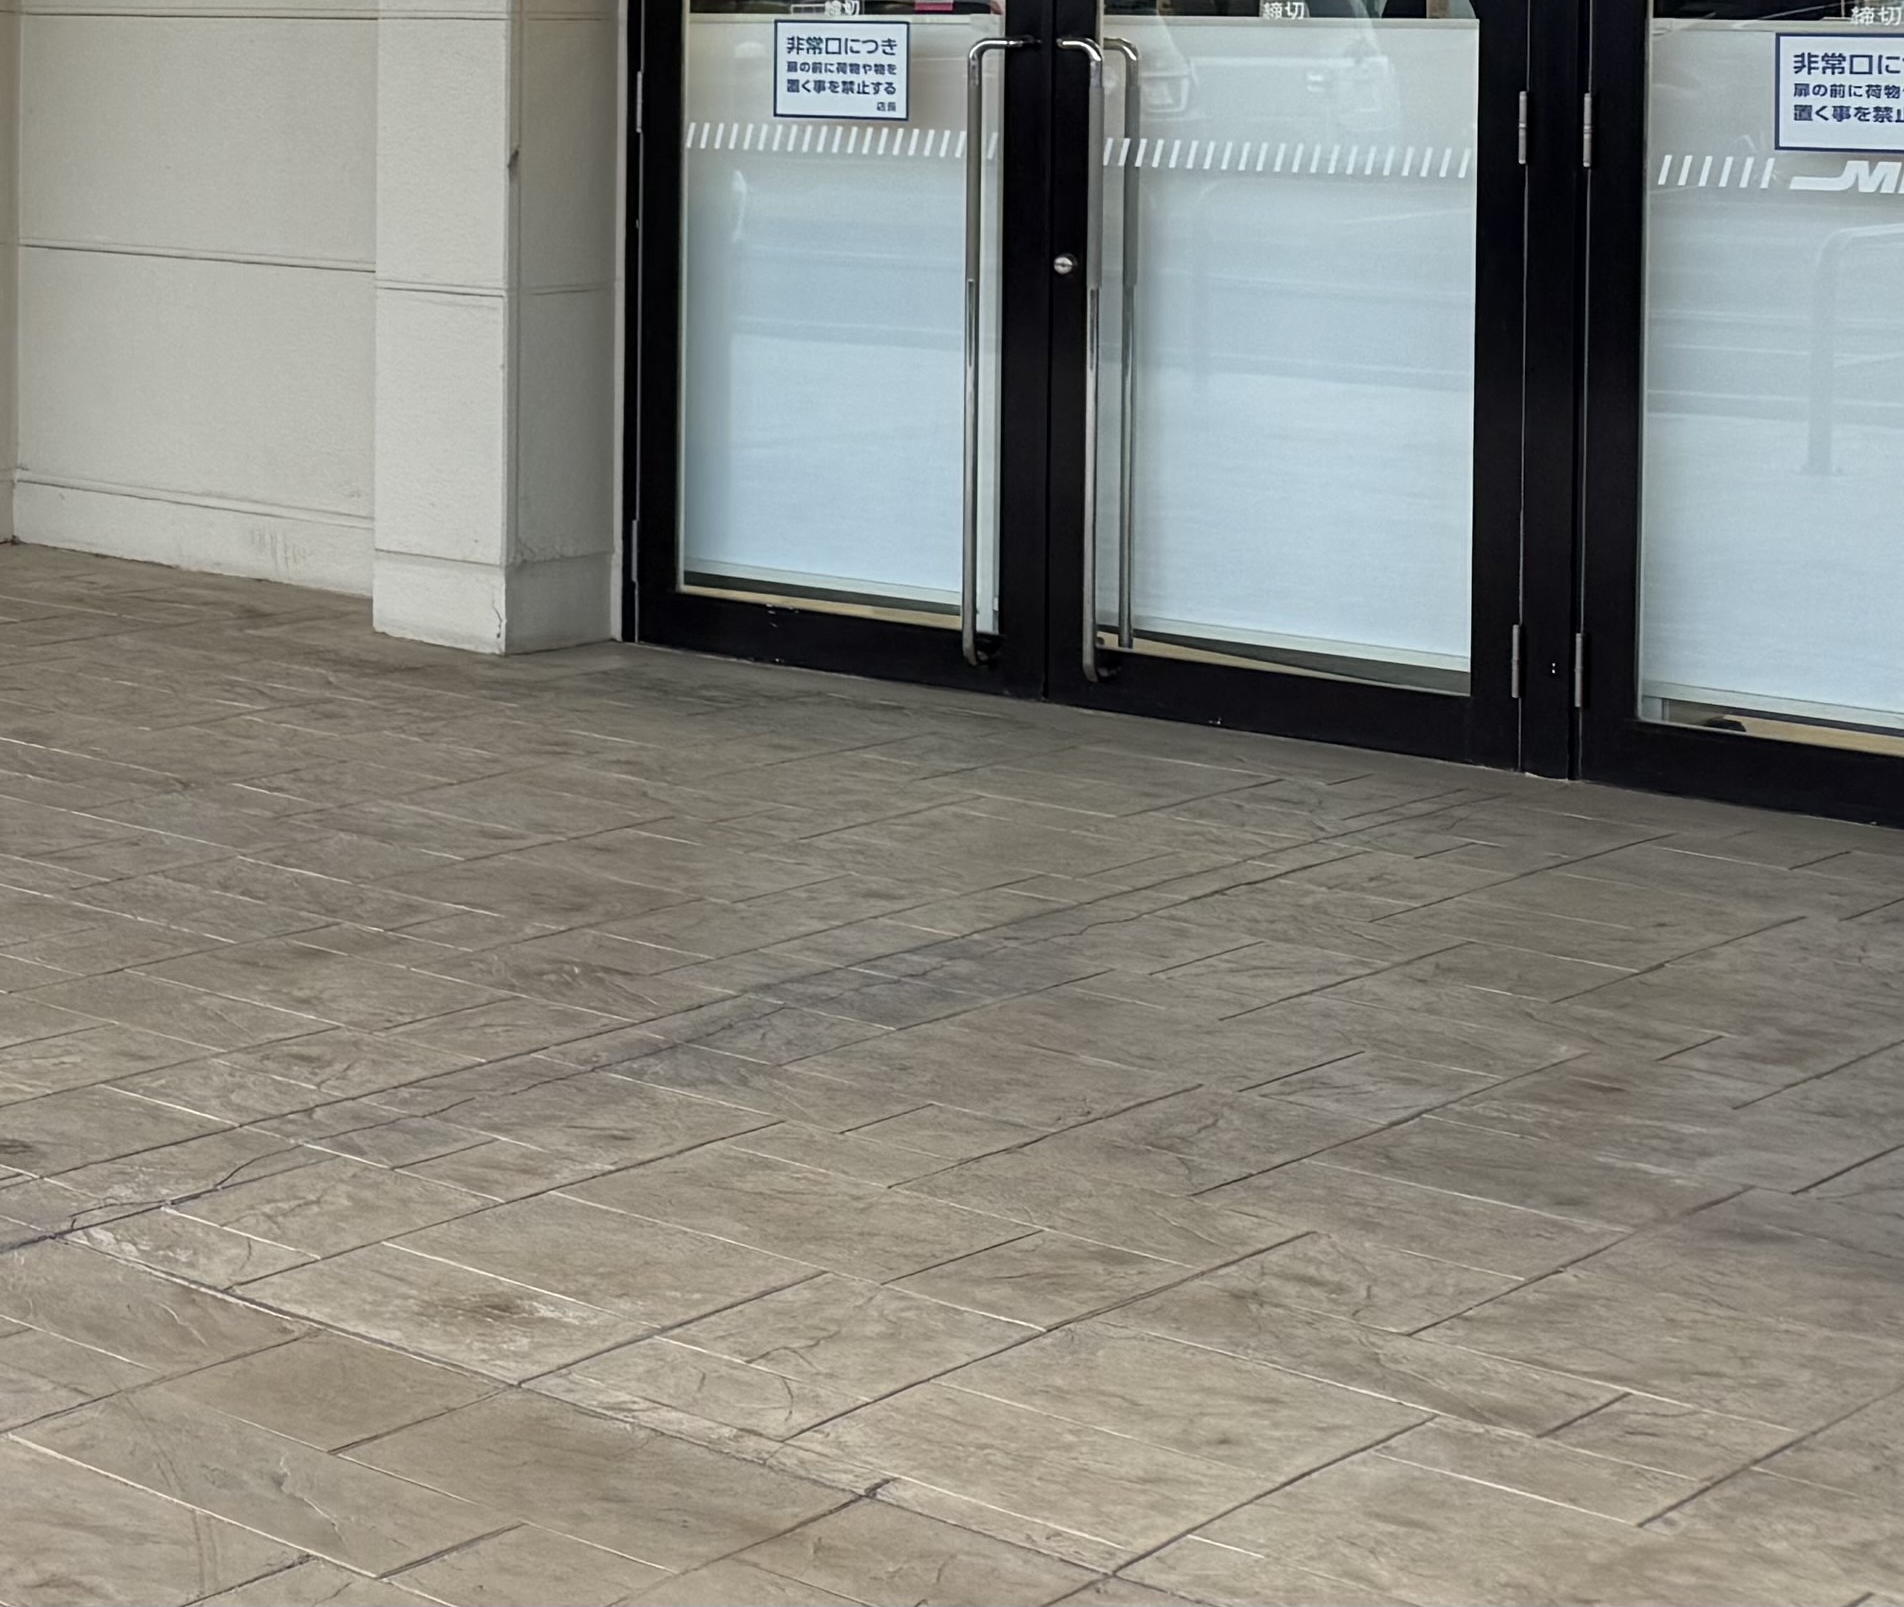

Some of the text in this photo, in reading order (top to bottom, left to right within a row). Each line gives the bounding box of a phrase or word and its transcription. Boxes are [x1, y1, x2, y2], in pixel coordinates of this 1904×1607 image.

[1263, 1, 1305, 20] 締切
[1851, 6, 1902, 26] 締切
[786, 36, 898, 56] 非常口につき
[786, 60, 898, 76] 扉の前に荷物や物を
[1793, 51, 1904, 76] 非常口に
[786, 78, 897, 96] 置く事を禁止する
[1793, 82, 1904, 100] 扉の前に荷物
[876, 101, 897, 113] 店長
